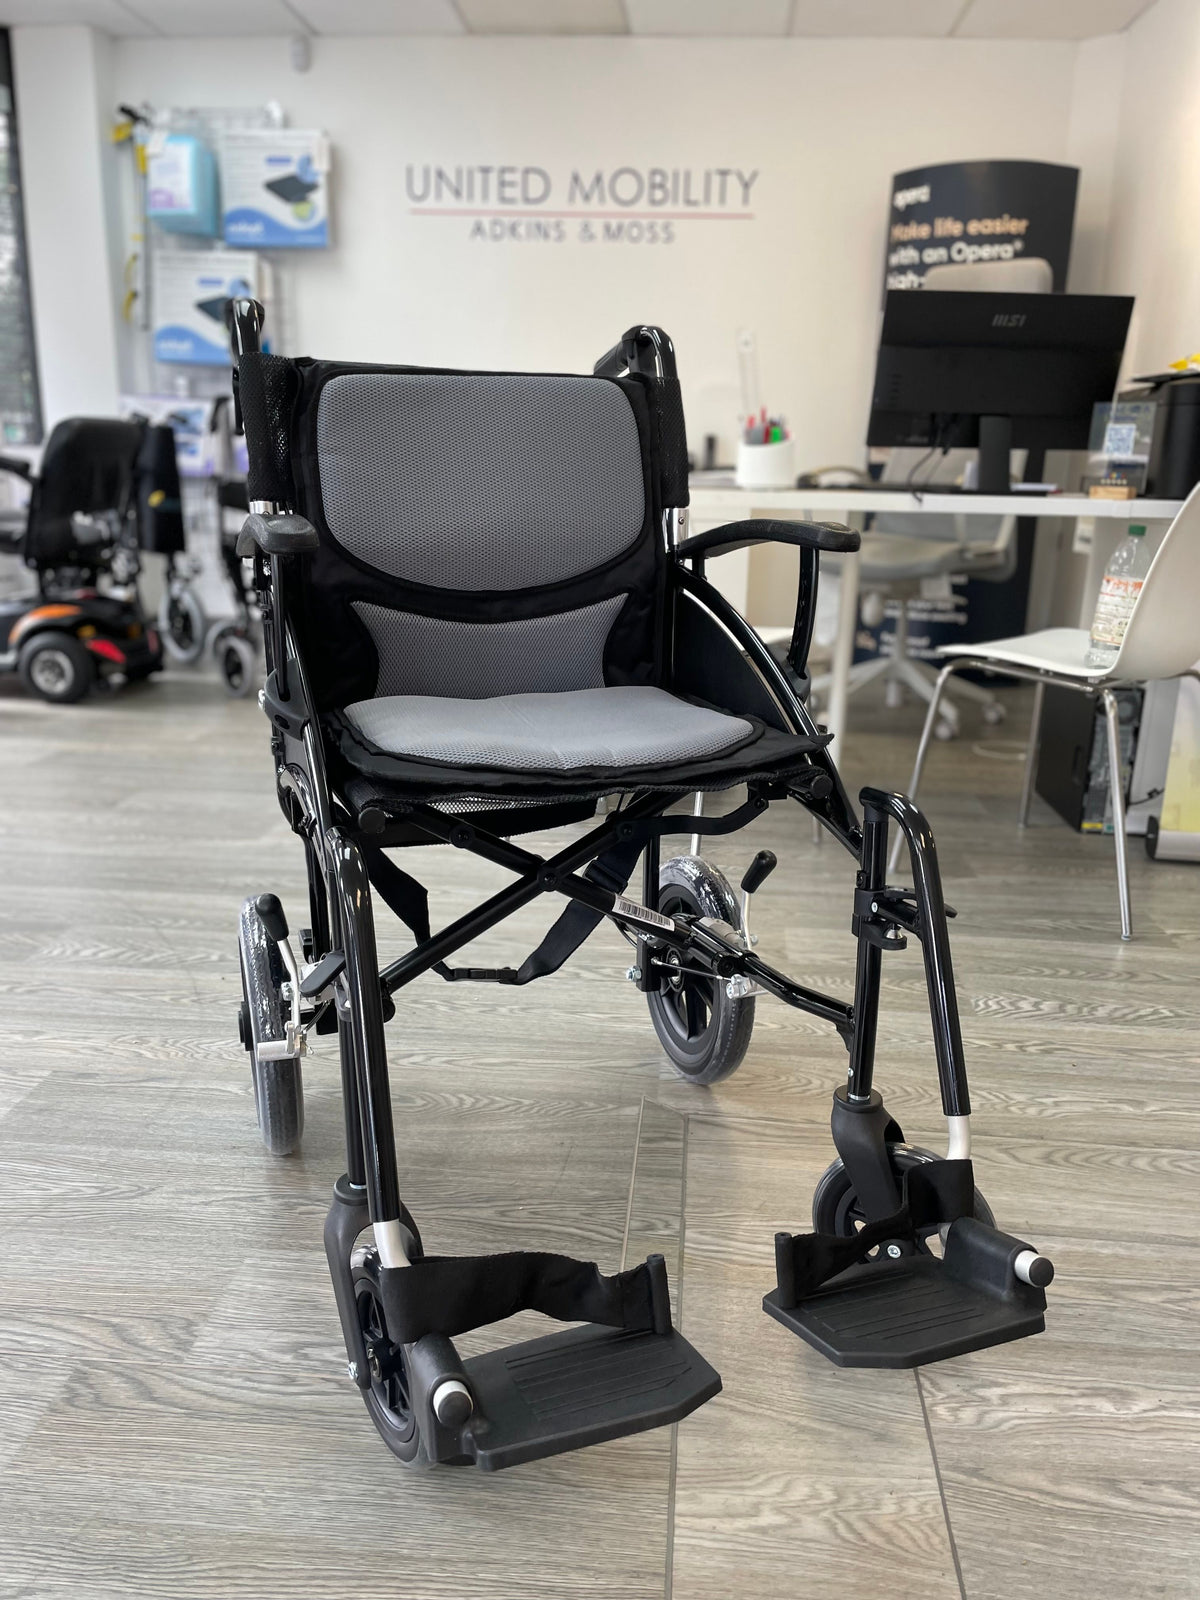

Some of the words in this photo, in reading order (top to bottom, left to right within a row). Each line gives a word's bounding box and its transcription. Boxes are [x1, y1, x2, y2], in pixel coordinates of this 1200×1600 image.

[405, 164, 552, 205] UNITED
[567, 166, 759, 208] MOBILITY
[470, 218, 566, 242] ADKINS
[579, 220, 597, 243] &
[603, 221, 675, 244] MOSS
[933, 216, 964, 238] life
[966, 213, 1030, 236] easier
[921, 246, 949, 264] an
[991, 313, 1027, 328] MSI
